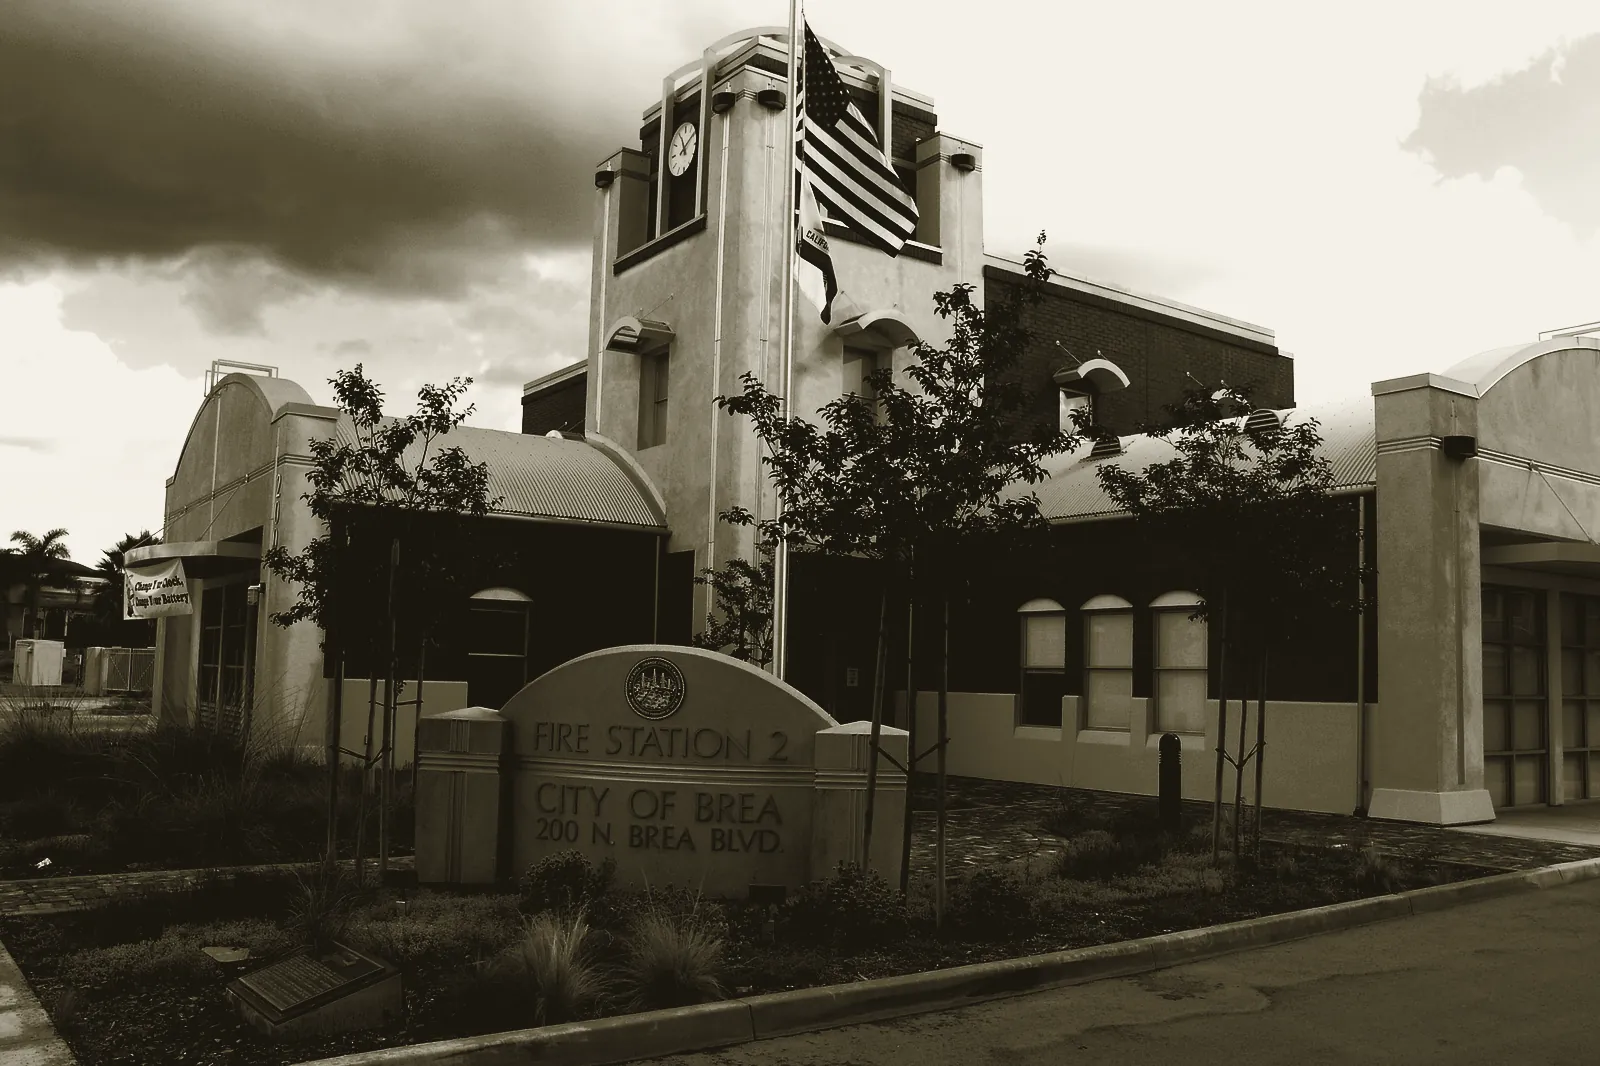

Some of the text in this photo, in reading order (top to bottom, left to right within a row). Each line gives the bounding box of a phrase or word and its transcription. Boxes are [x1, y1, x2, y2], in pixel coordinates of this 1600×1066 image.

[161, 593, 188, 604] Battery
[533, 722, 789, 762] FIRE STATION 2
[536, 783, 784, 826] CITY OF BREA
[535, 818, 579, 842] 200
[629, 824, 696, 852] BREA
[710, 828, 785, 854] BLVD.
